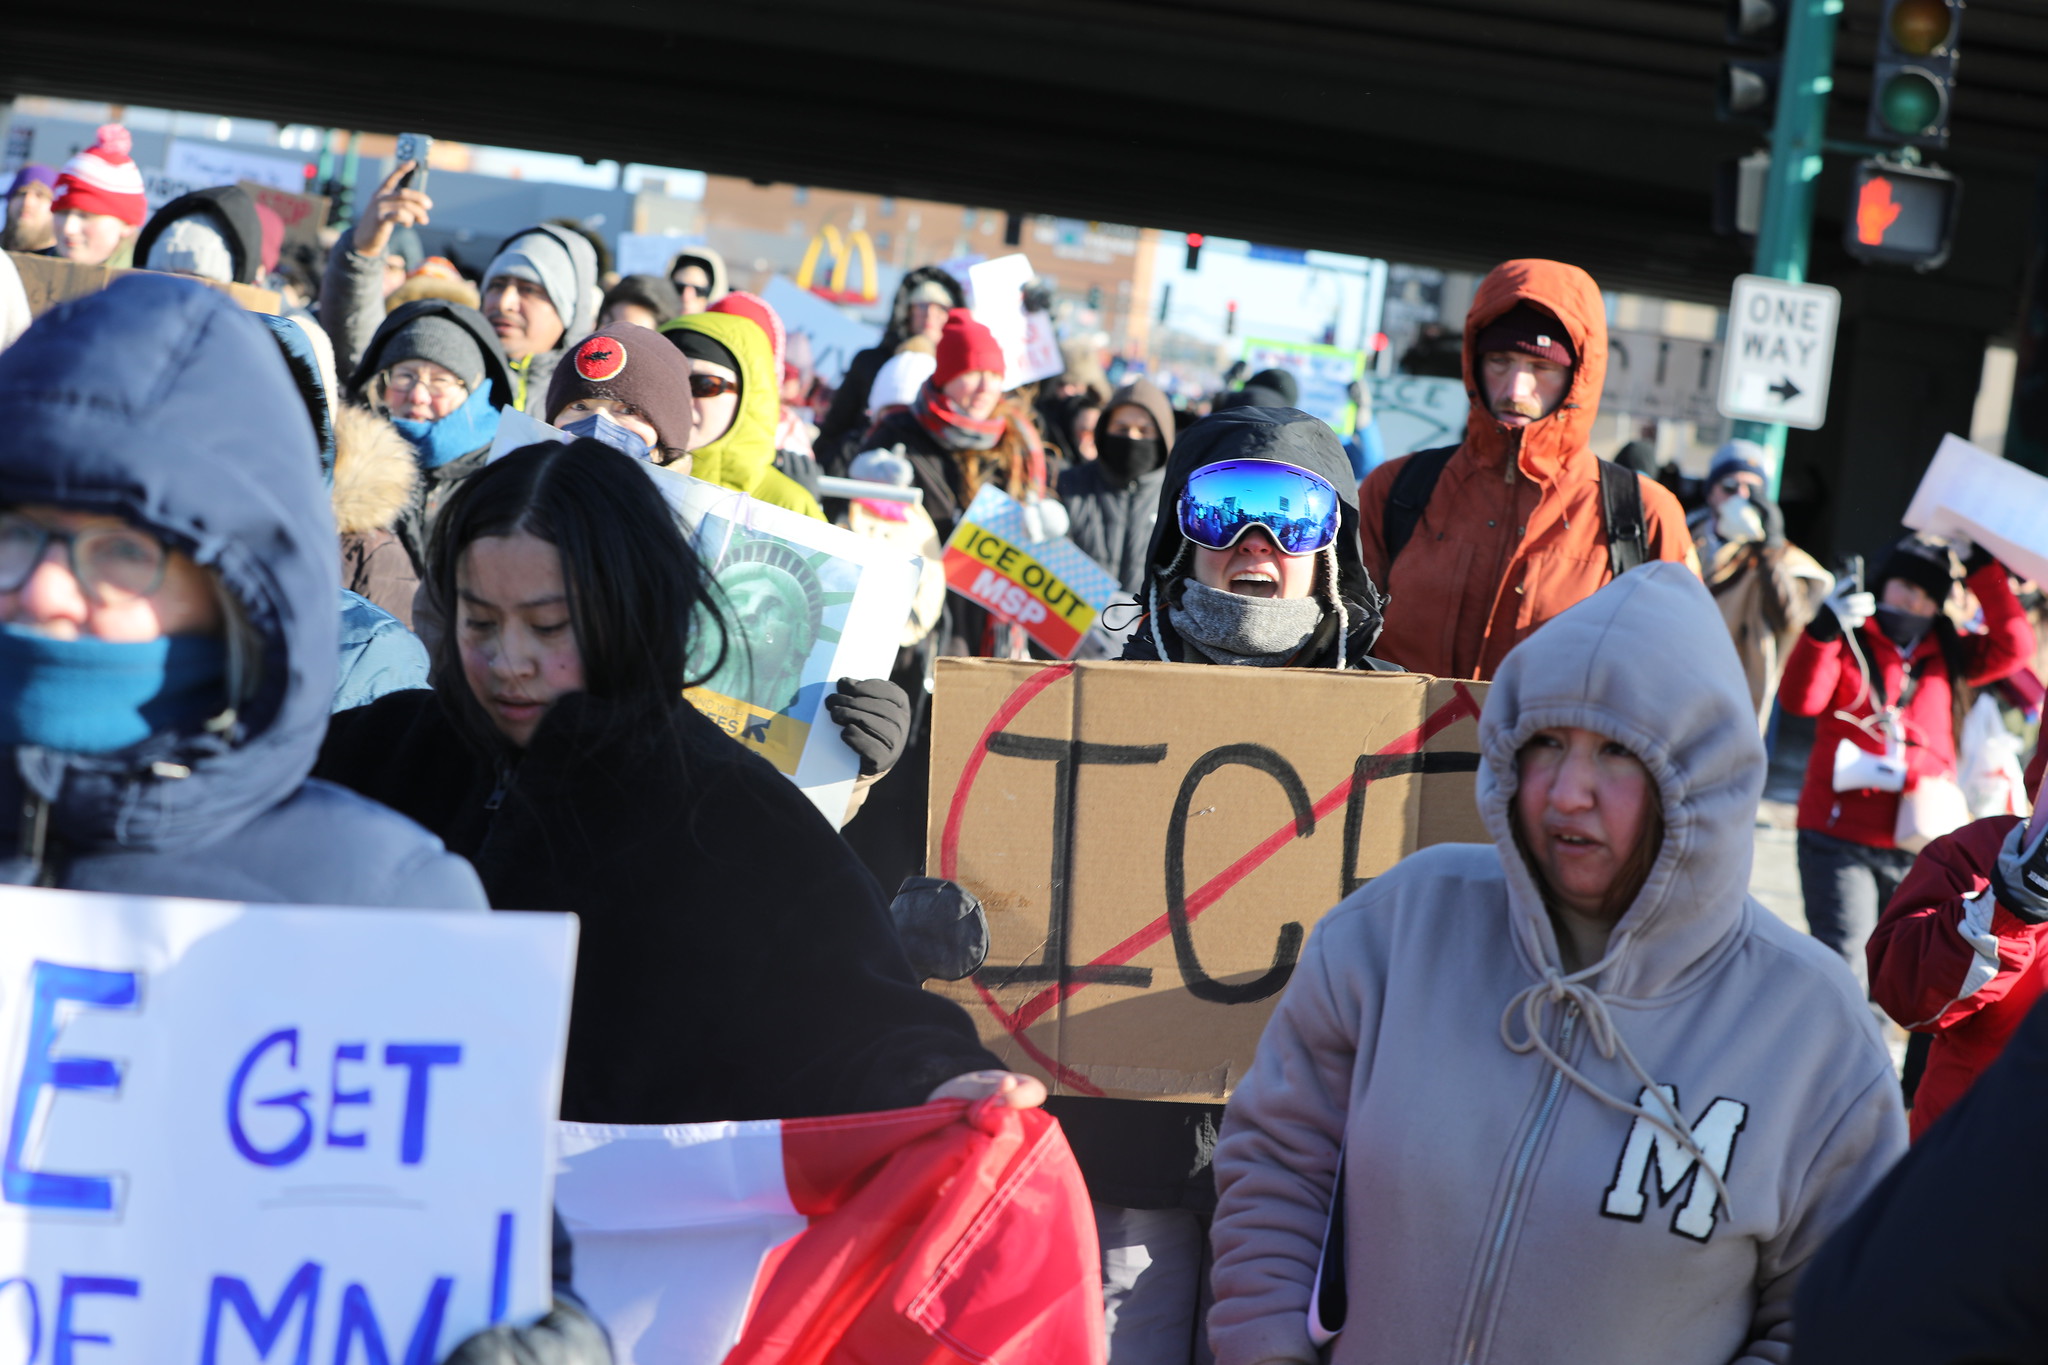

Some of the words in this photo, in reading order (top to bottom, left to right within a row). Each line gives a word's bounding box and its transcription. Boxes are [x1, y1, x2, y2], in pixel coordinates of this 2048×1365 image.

[1748, 292, 1818, 333] ONE
[1743, 331, 1817, 366] WAY
[965, 529, 1020, 573] ICE
[1022, 564, 1086, 618] OUT
[970, 567, 1048, 624] MSP
[683, 690, 715, 711] TAND
[227, 1028, 463, 1167] GET
[1601, 1083, 1748, 1243] M
